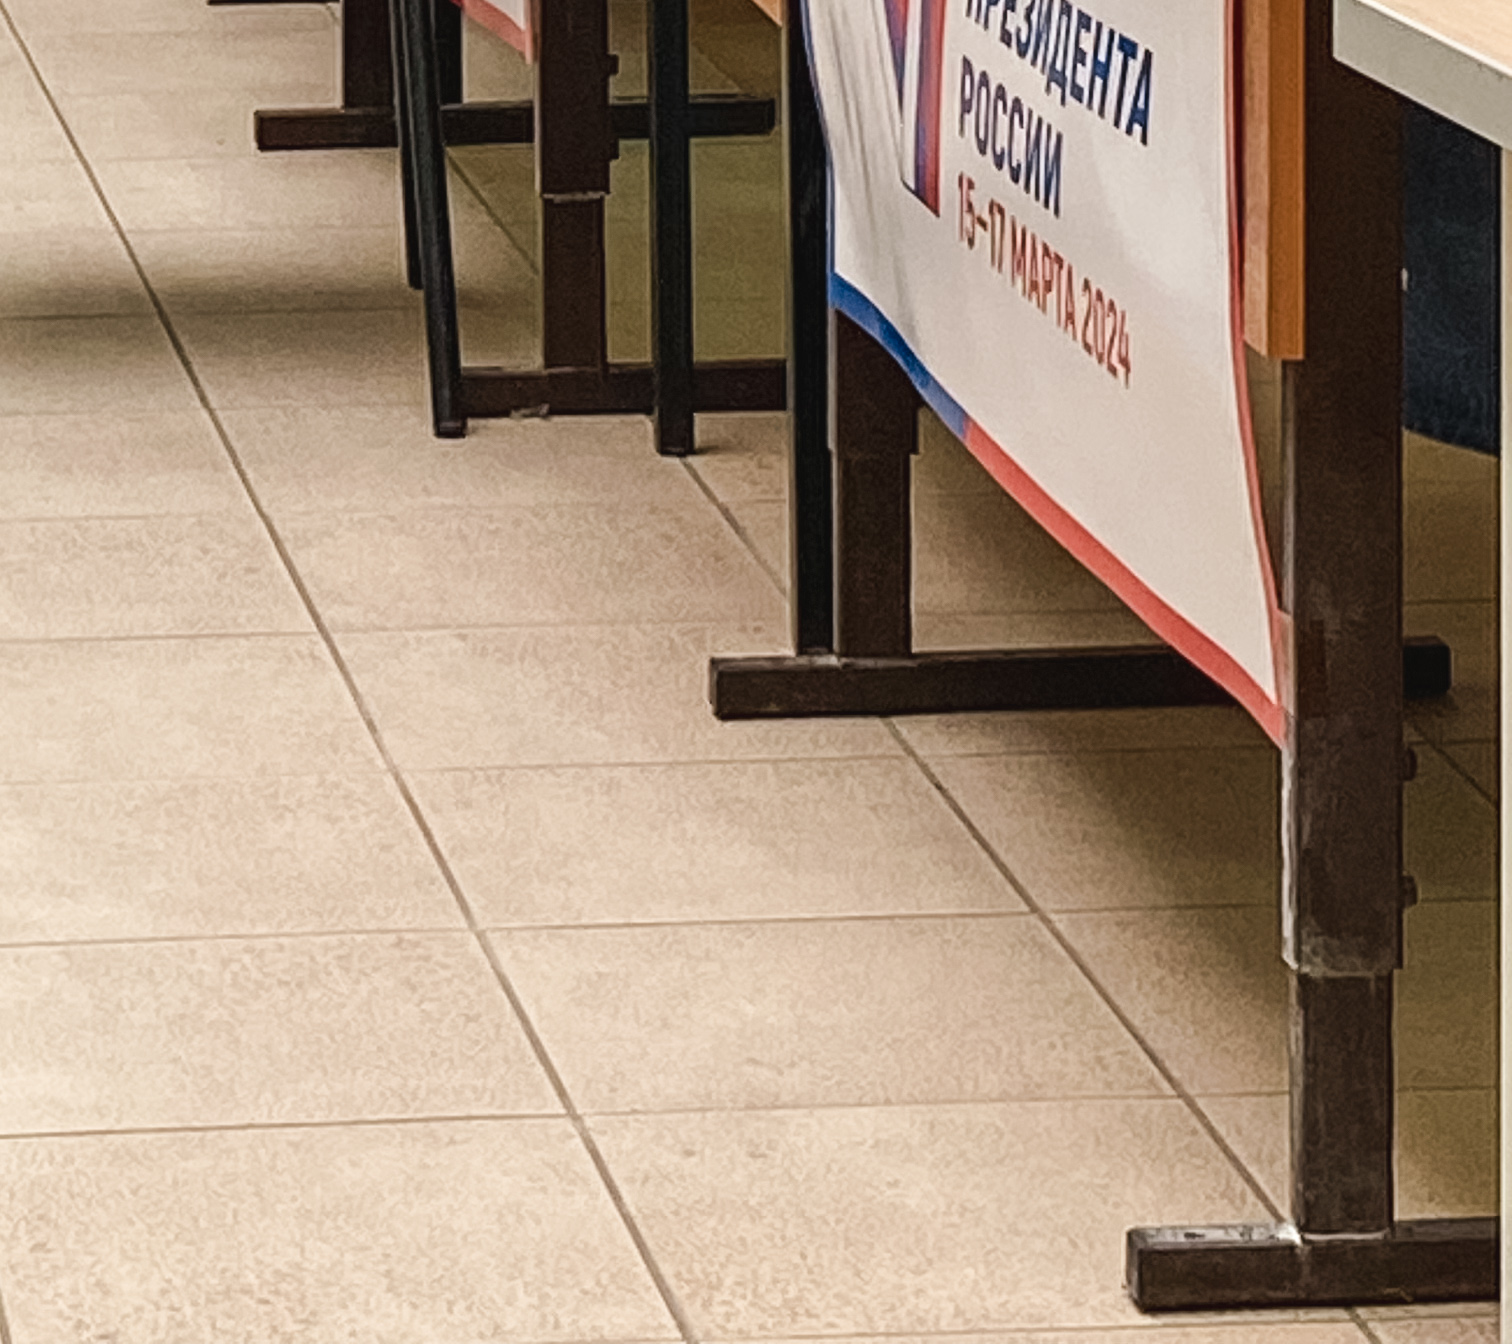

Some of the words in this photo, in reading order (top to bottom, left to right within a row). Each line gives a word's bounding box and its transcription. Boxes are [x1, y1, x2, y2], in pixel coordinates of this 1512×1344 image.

[957, 54, 1064, 219] РОССИИ
[1009, 214, 1078, 342] МАРТА
[1081, 277, 1132, 389] 2024
